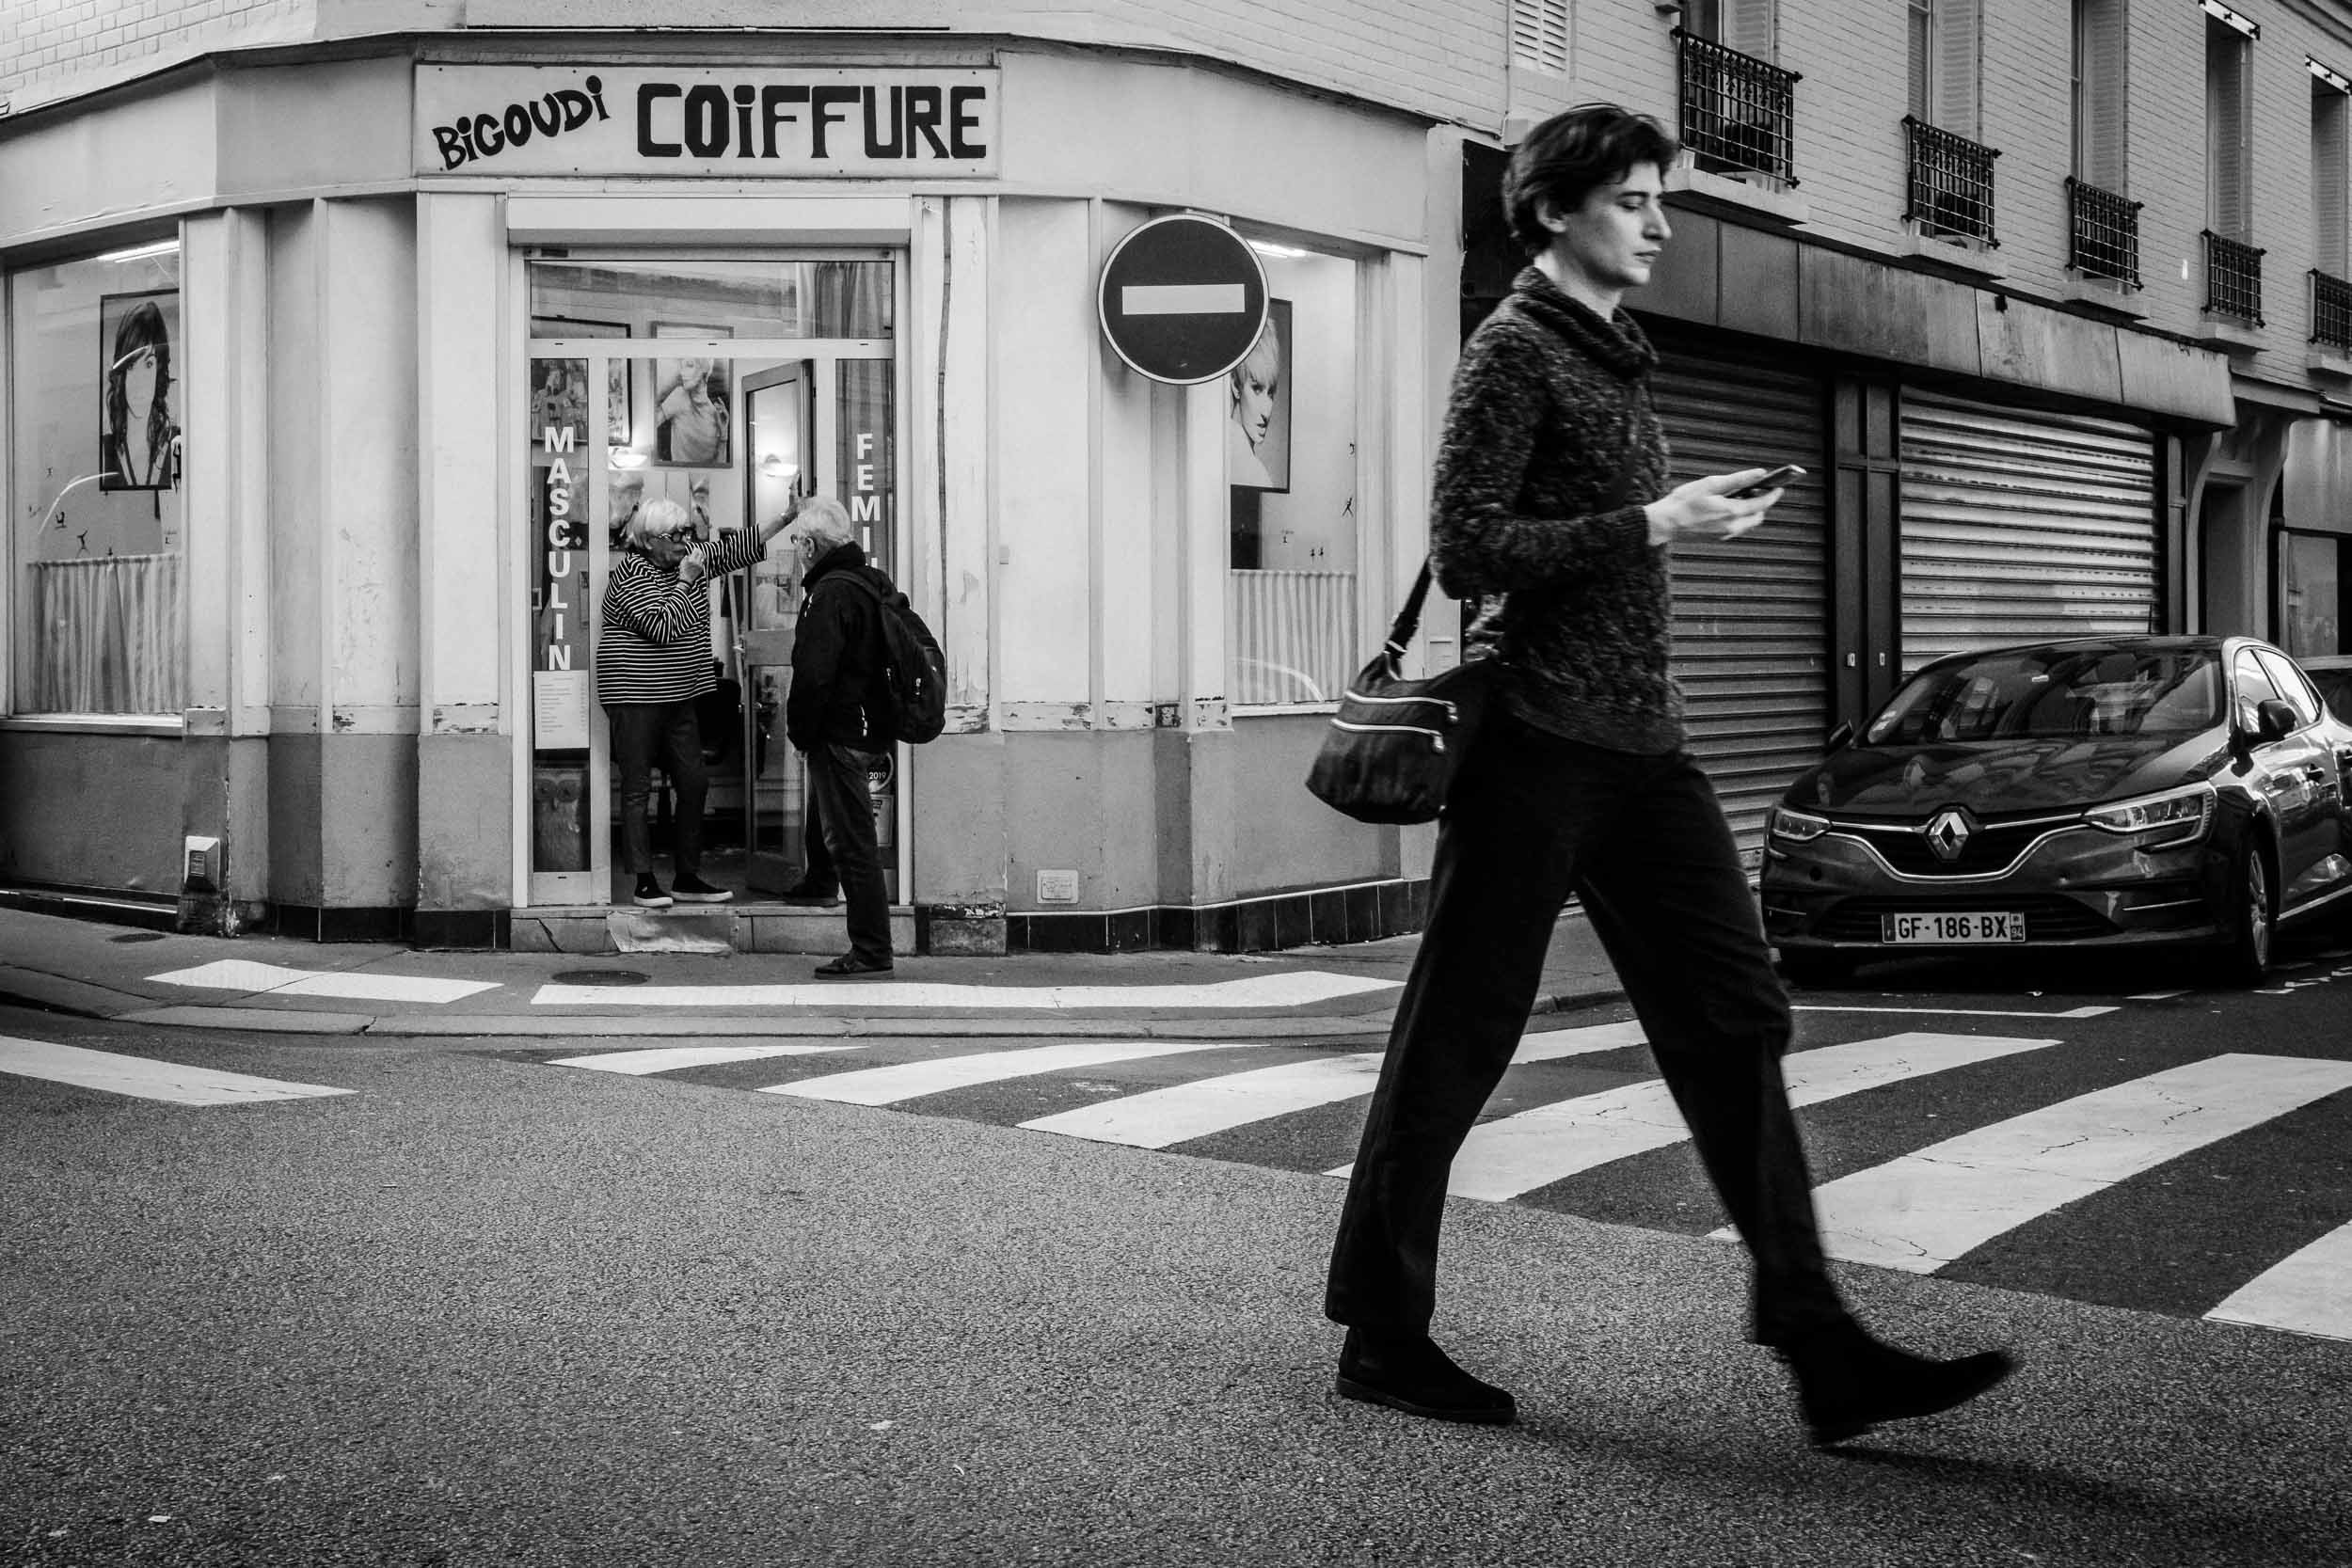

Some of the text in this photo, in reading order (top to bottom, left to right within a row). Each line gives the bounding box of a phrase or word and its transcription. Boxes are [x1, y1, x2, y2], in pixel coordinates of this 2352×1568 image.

[544, 426, 575, 671] MASCULIN
[851, 433, 881, 568] FEMI
[1898, 916, 2008, 939] GF-186-BX
